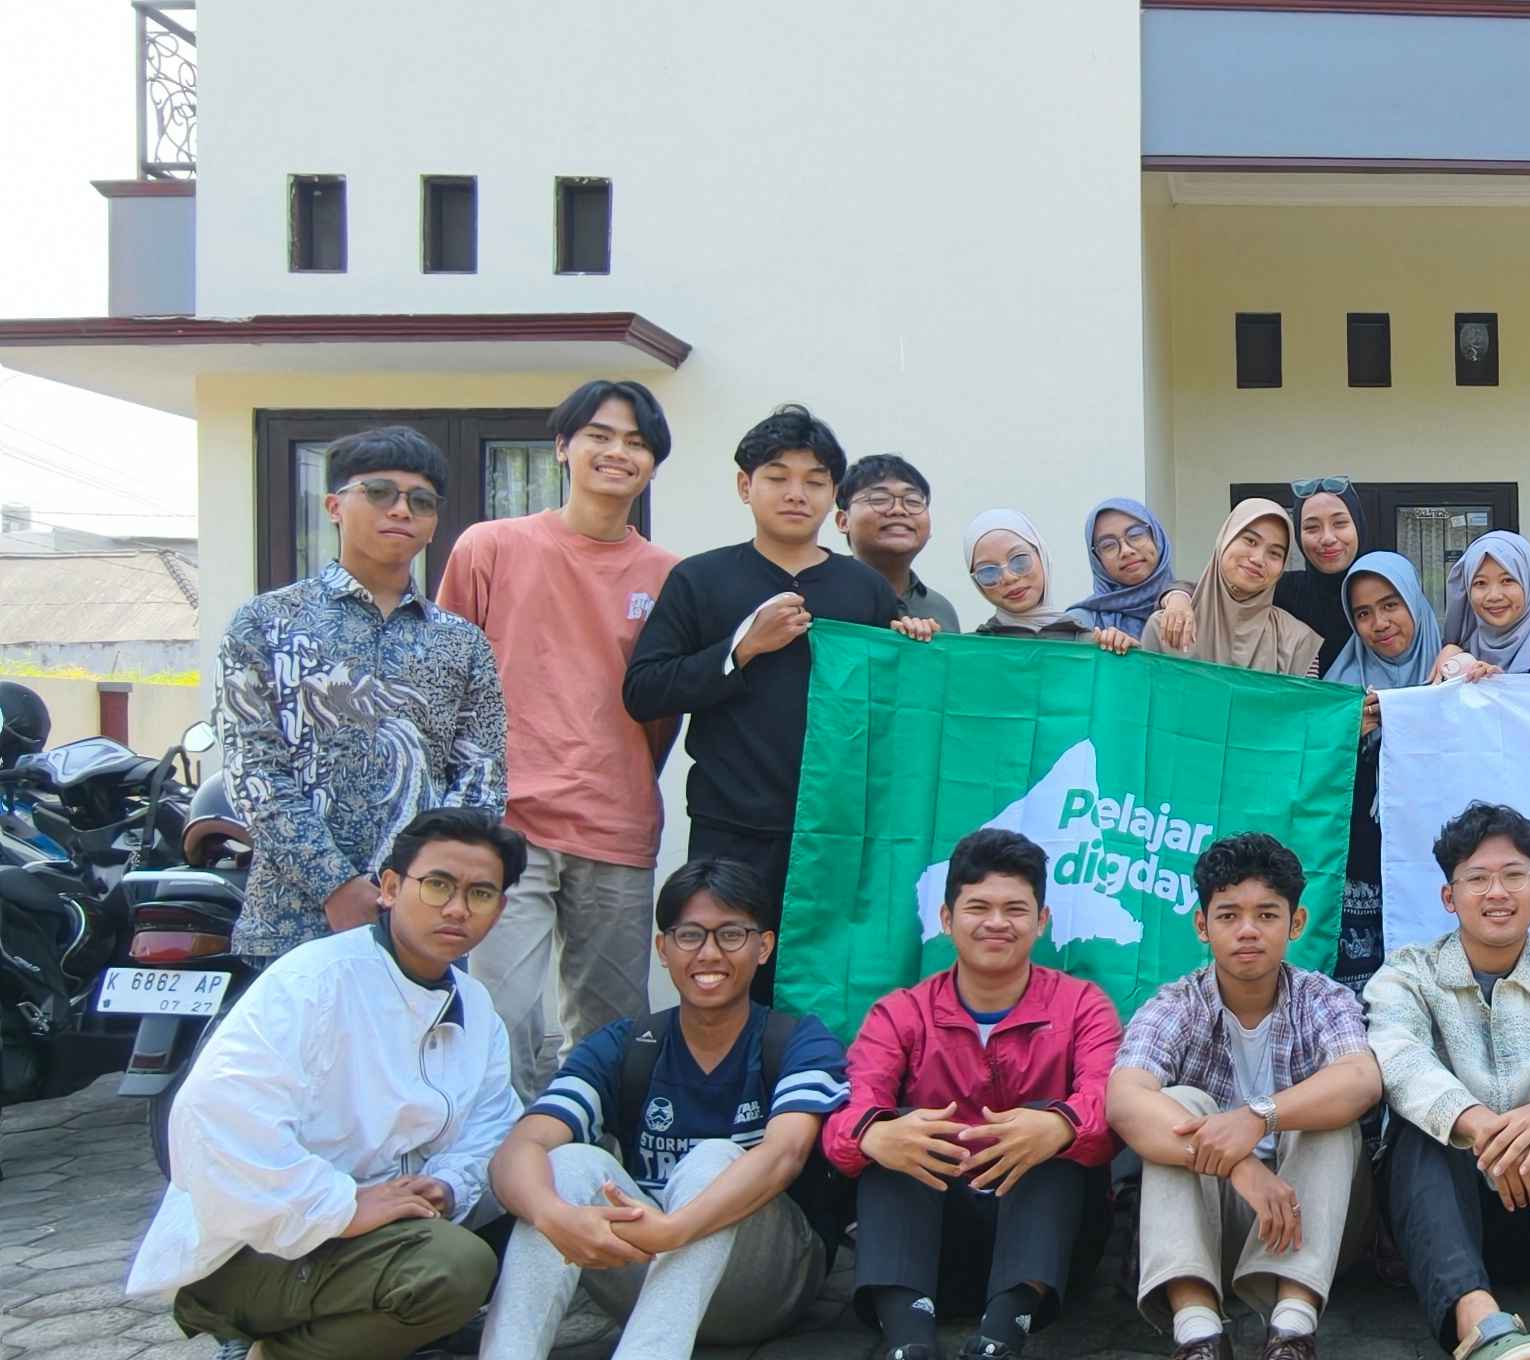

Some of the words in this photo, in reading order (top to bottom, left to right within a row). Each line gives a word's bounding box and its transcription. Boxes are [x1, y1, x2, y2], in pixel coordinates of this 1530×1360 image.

[1058, 789, 1213, 854] Pelajar
[106, 972, 120, 991] K
[131, 972, 181, 992] 6862
[194, 975, 222, 993] AP
[640, 1131, 688, 1152] STORM
[640, 1147, 688, 1180] TR
